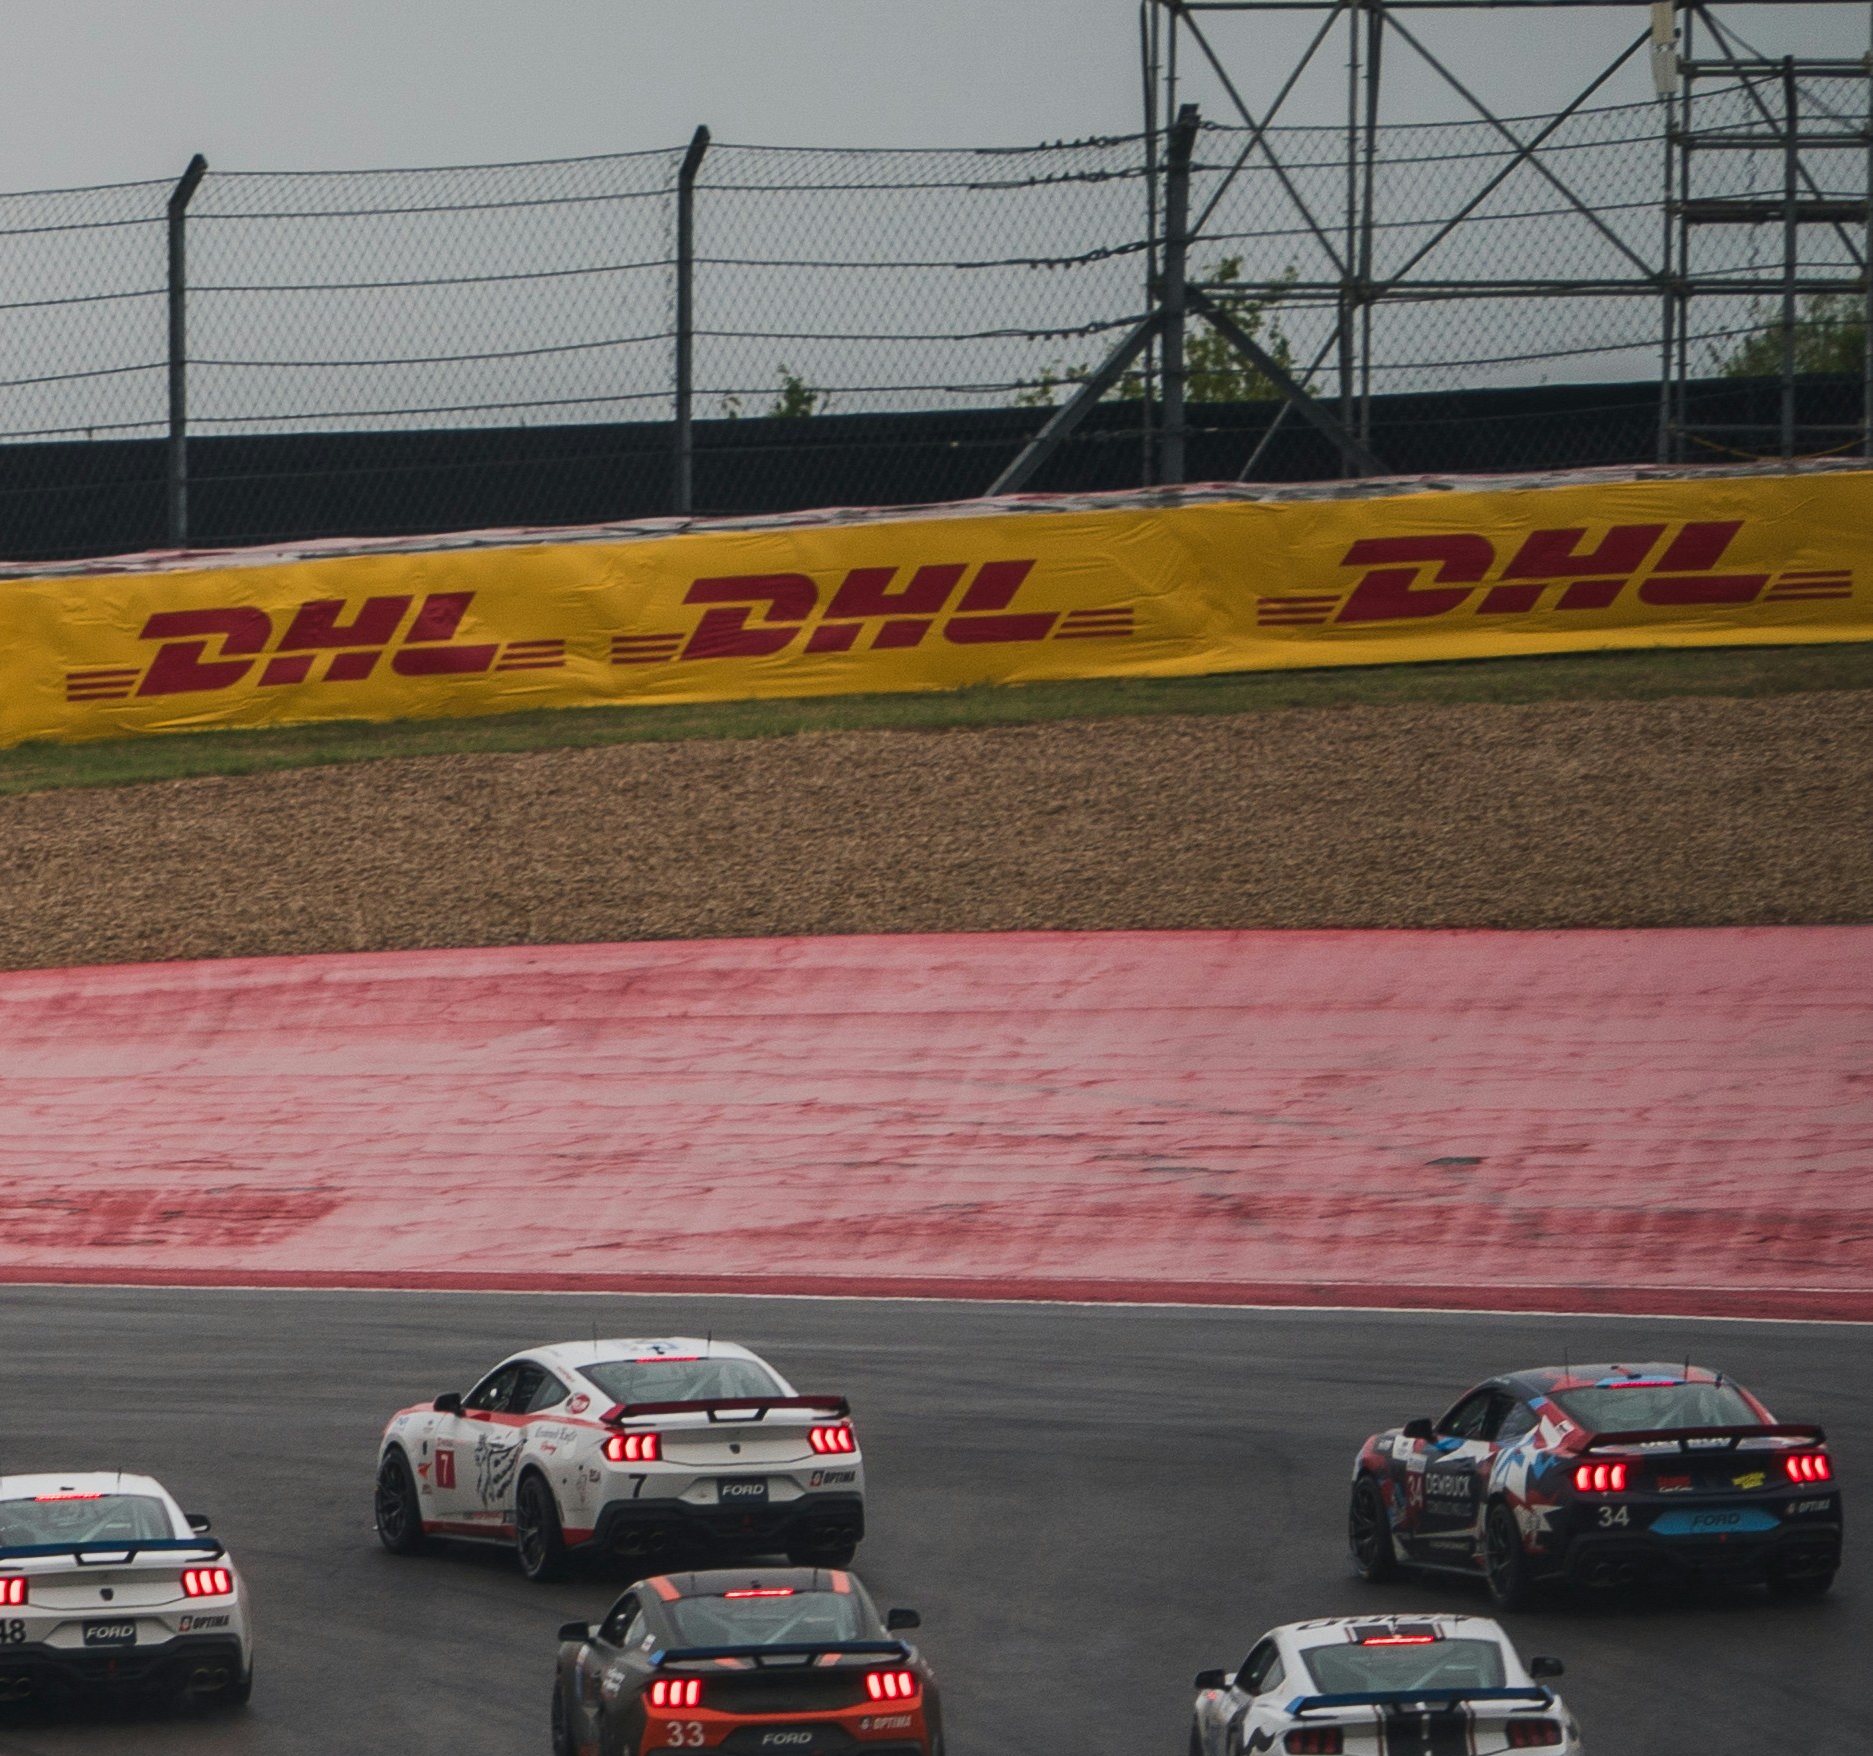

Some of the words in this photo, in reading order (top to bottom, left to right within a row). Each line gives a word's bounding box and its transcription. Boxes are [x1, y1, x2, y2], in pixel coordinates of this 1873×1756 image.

[1333, 519, 1772, 622] DHL
[679, 561, 1056, 660] DHL
[137, 591, 498, 697] DHL
[441, 1454, 450, 1484] 7
[824, 1470, 856, 1484] OPTIMA
[629, 1474, 647, 1498] 7
[722, 1484, 765, 1496] FORD
[1407, 1475, 1424, 1508] 34
[1598, 1505, 1630, 1528] 34
[1693, 1513, 1741, 1527] FORD
[86, 1625, 135, 1640] FORD
[192, 1615, 230, 1631] OPTIMA
[667, 1721, 705, 1748] 33
[873, 1715, 912, 1731] OPTIMA
[762, 1731, 812, 1746] FORD
